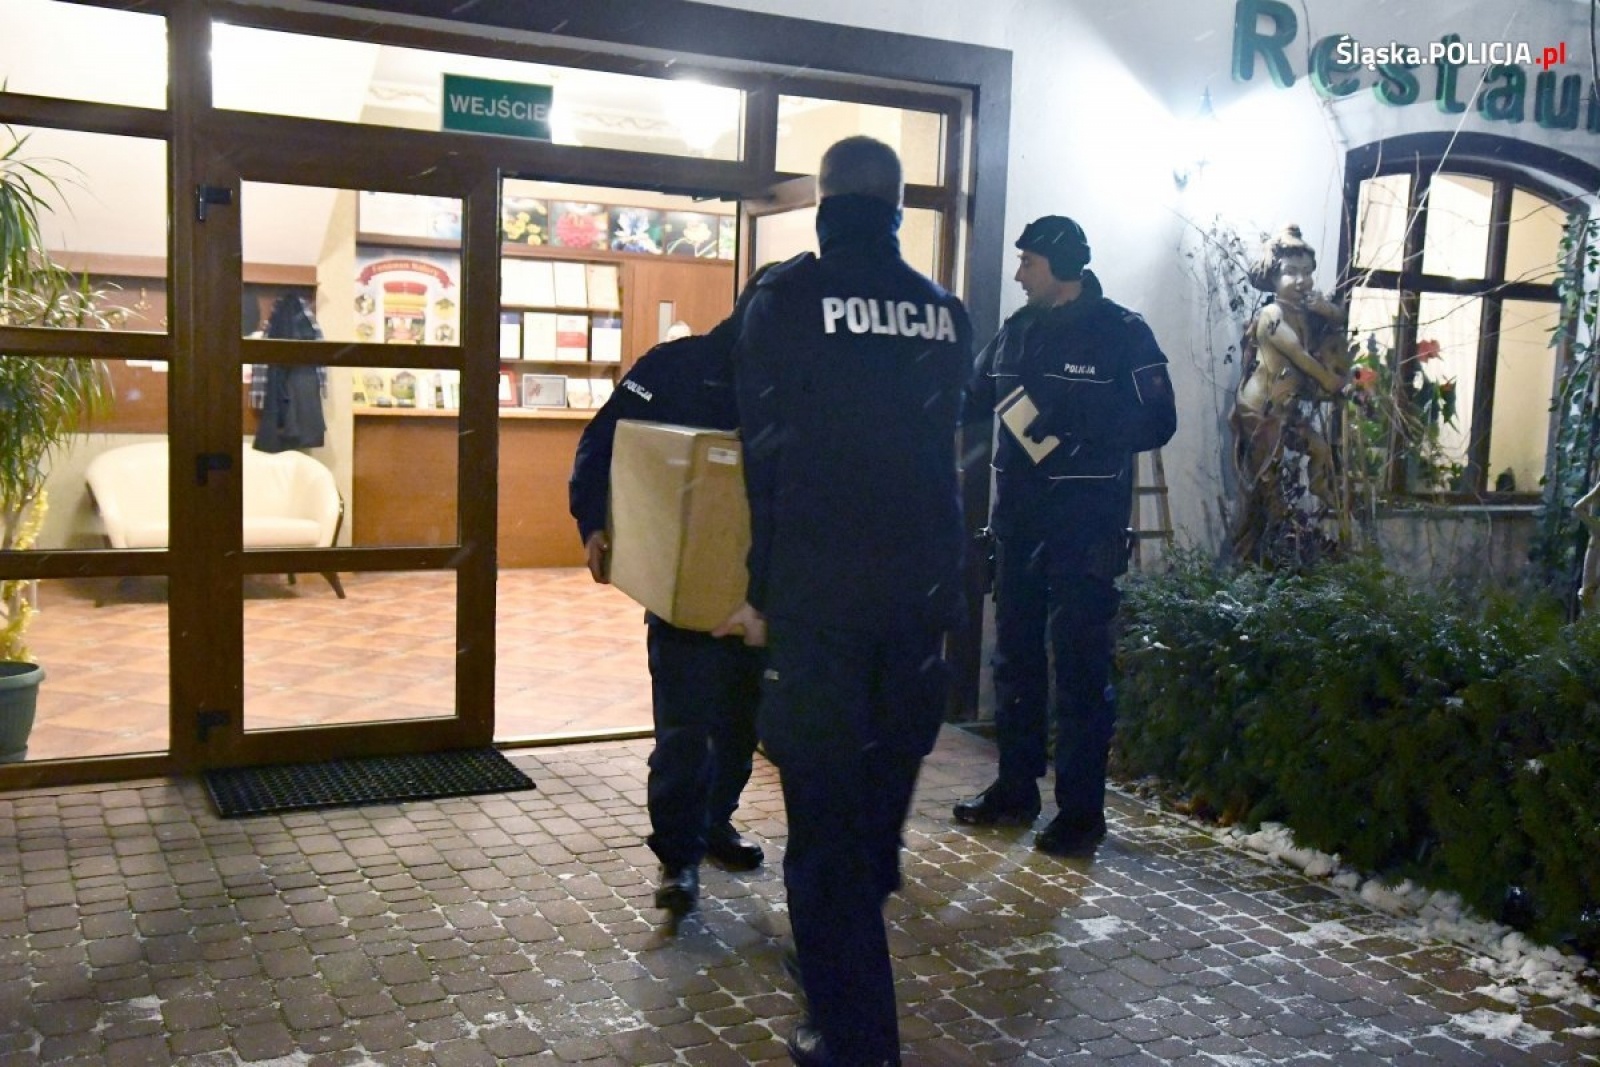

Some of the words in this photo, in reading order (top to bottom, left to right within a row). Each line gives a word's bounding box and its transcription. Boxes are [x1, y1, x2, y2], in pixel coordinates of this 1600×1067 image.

[449, 94, 550, 121] WEJŚCIE
[822, 297, 957, 343] POLICJA
[1064, 363, 1096, 375] POLICJA
[622, 379, 653, 402] POLICJA
